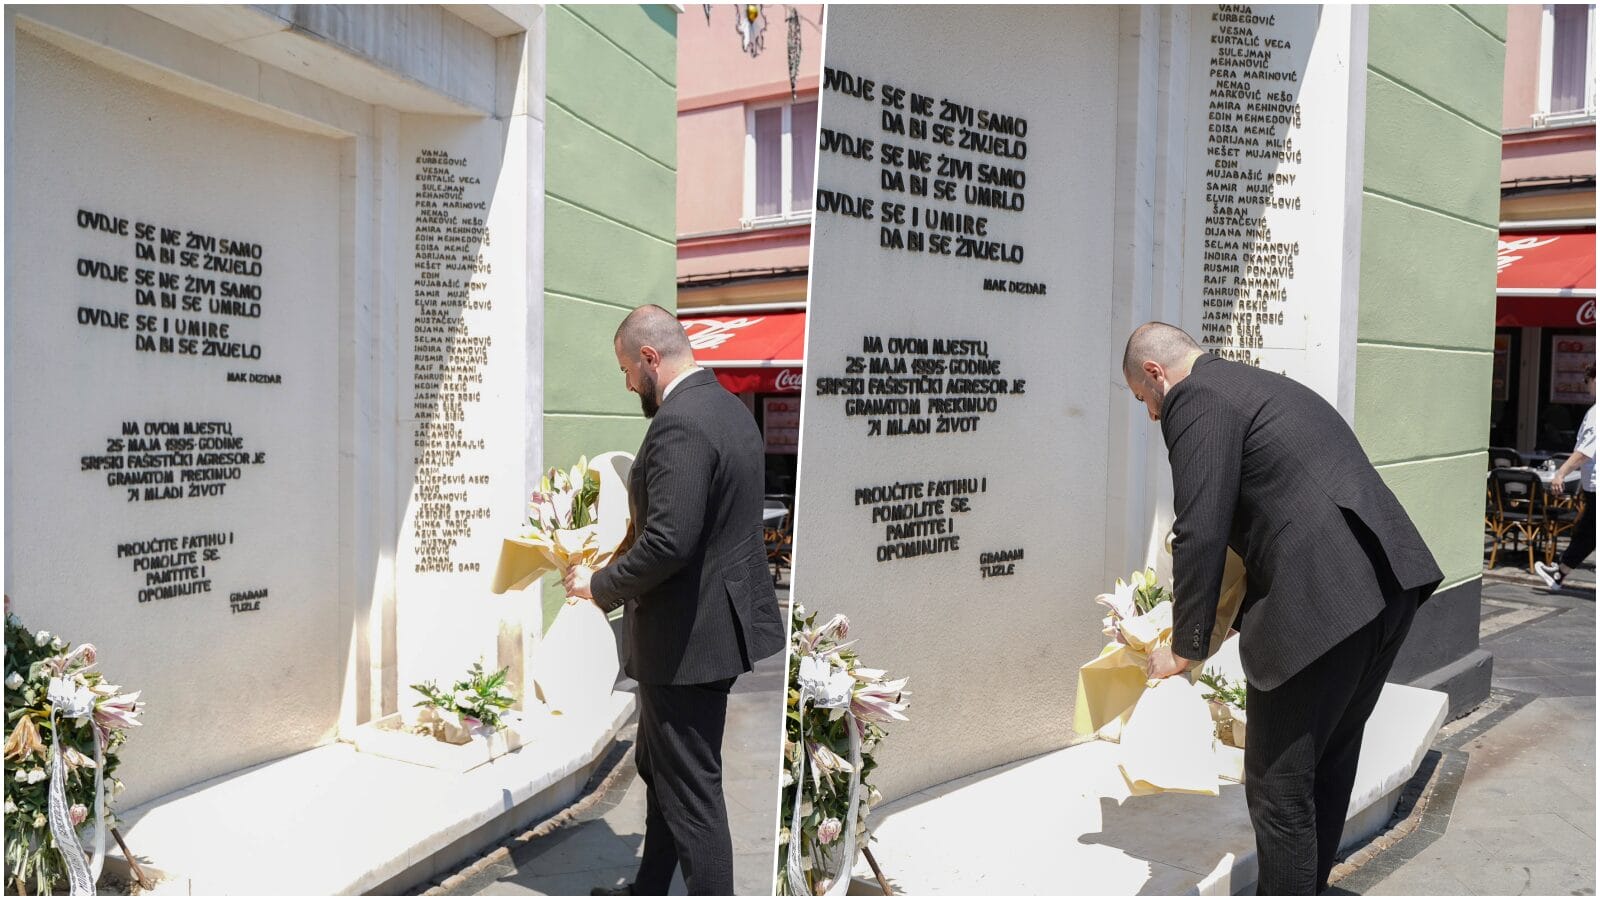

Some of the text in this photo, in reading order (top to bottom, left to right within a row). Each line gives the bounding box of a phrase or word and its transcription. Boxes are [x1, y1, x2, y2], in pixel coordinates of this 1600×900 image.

[1219, 4, 1252, 14] VANJA
[1212, 13, 1275, 25] KURBEGOVIĆ
[1220, 26, 1252, 36] VESNA
[1211, 35, 1291, 49] KURTALIĆ VECA
[1211, 56, 1268, 68] MEHANOVIĆ
[1219, 48, 1271, 59] SULEJMAN
[1210, 69, 1297, 81] PERA MARINOVIĆ
[1217, 81, 1250, 90] NENAD
[1210, 90, 1292, 102] MARKOVIĆ NEŠO
[882, 85, 905, 109] SE
[911, 93, 934, 117] NE
[940, 99, 974, 126] ŽIVI
[978, 110, 1027, 137] SAMO
[1209, 101, 1301, 114] AMIRA MEHINOVIĆ
[882, 110, 1026, 160] DA BI SE ŽIVJELO
[1209, 124, 1275, 136] EDISA MEMIĆ
[1209, 135, 1292, 150] ADRIJANA MILIĆ
[881, 144, 904, 167] SE
[908, 149, 932, 172] NE
[938, 154, 972, 180] ŽIVI
[978, 164, 1025, 190] SAMO
[1215, 160, 1237, 168] EDIN
[1207, 169, 1295, 185] MUJABAŠIĆ MONY
[881, 169, 1024, 211] DA BI SE UMRLO
[1207, 183, 1274, 195] SAMIR MUJIĆ
[817, 189, 987, 236] OVDJE SE I UMIRE
[1213, 202, 1248, 215] ŠABAN
[77, 209, 262, 259] OVDJE SE NE ŽIVI SAMO
[1205, 228, 1270, 241] DIJANA NINIĆ
[880, 226, 1023, 264] DA BI SE ŽIVJELO
[136, 243, 262, 276] DA BI SE ŽIVJELO
[77, 258, 261, 300] OVDJE SE NE ŽIVI SAMO
[984, 279, 1046, 295] MAK DIZDAR
[136, 290, 260, 318] DA BI SE UMRLO
[78, 307, 229, 339] OVDJE SE I UMIRE
[136, 335, 261, 359] DA BI SE ŽIVJELO
[864, 336, 883, 353] NA
[888, 338, 928, 355] OVOM
[870, 357, 907, 373] MAJA
[950, 360, 1000, 374] GODINE
[227, 372, 281, 383] MAK DIZDAR
[816, 377, 864, 395] SRPSKI
[946, 379, 1007, 394] AGRESOR
[1010, 380, 1026, 394] JE
[846, 398, 997, 416] GRANATOM PREKINUO
[122, 422, 139, 435] NA
[144, 422, 179, 435] OVOM
[867, 415, 980, 436] 71 MLADI ŽIVOT
[128, 439, 161, 451] MAJA
[199, 438, 243, 450] GODINE
[81, 456, 123, 471] SRPSKI
[197, 453, 249, 466] AGRESOR
[252, 452, 265, 465] JE
[108, 468, 241, 486] GRANATOM PREKINUO
[128, 483, 226, 502] 71 MLADI ŽIVOT
[928, 478, 978, 497] FATIHU
[982, 478, 986, 492] I
[872, 500, 944, 523] POMOLITE
[886, 518, 953, 541] PAMTITE I
[182, 533, 226, 549] FATIHU
[230, 532, 233, 544] I
[877, 536, 959, 562] OPOMINJITE
[134, 551, 196, 572] POMOLITE
[147, 566, 205, 585] PAMTITE I
[981, 564, 1015, 578] TUZLE
[139, 580, 211, 603] OPOMINJITE
[231, 602, 260, 613] TUZLE
